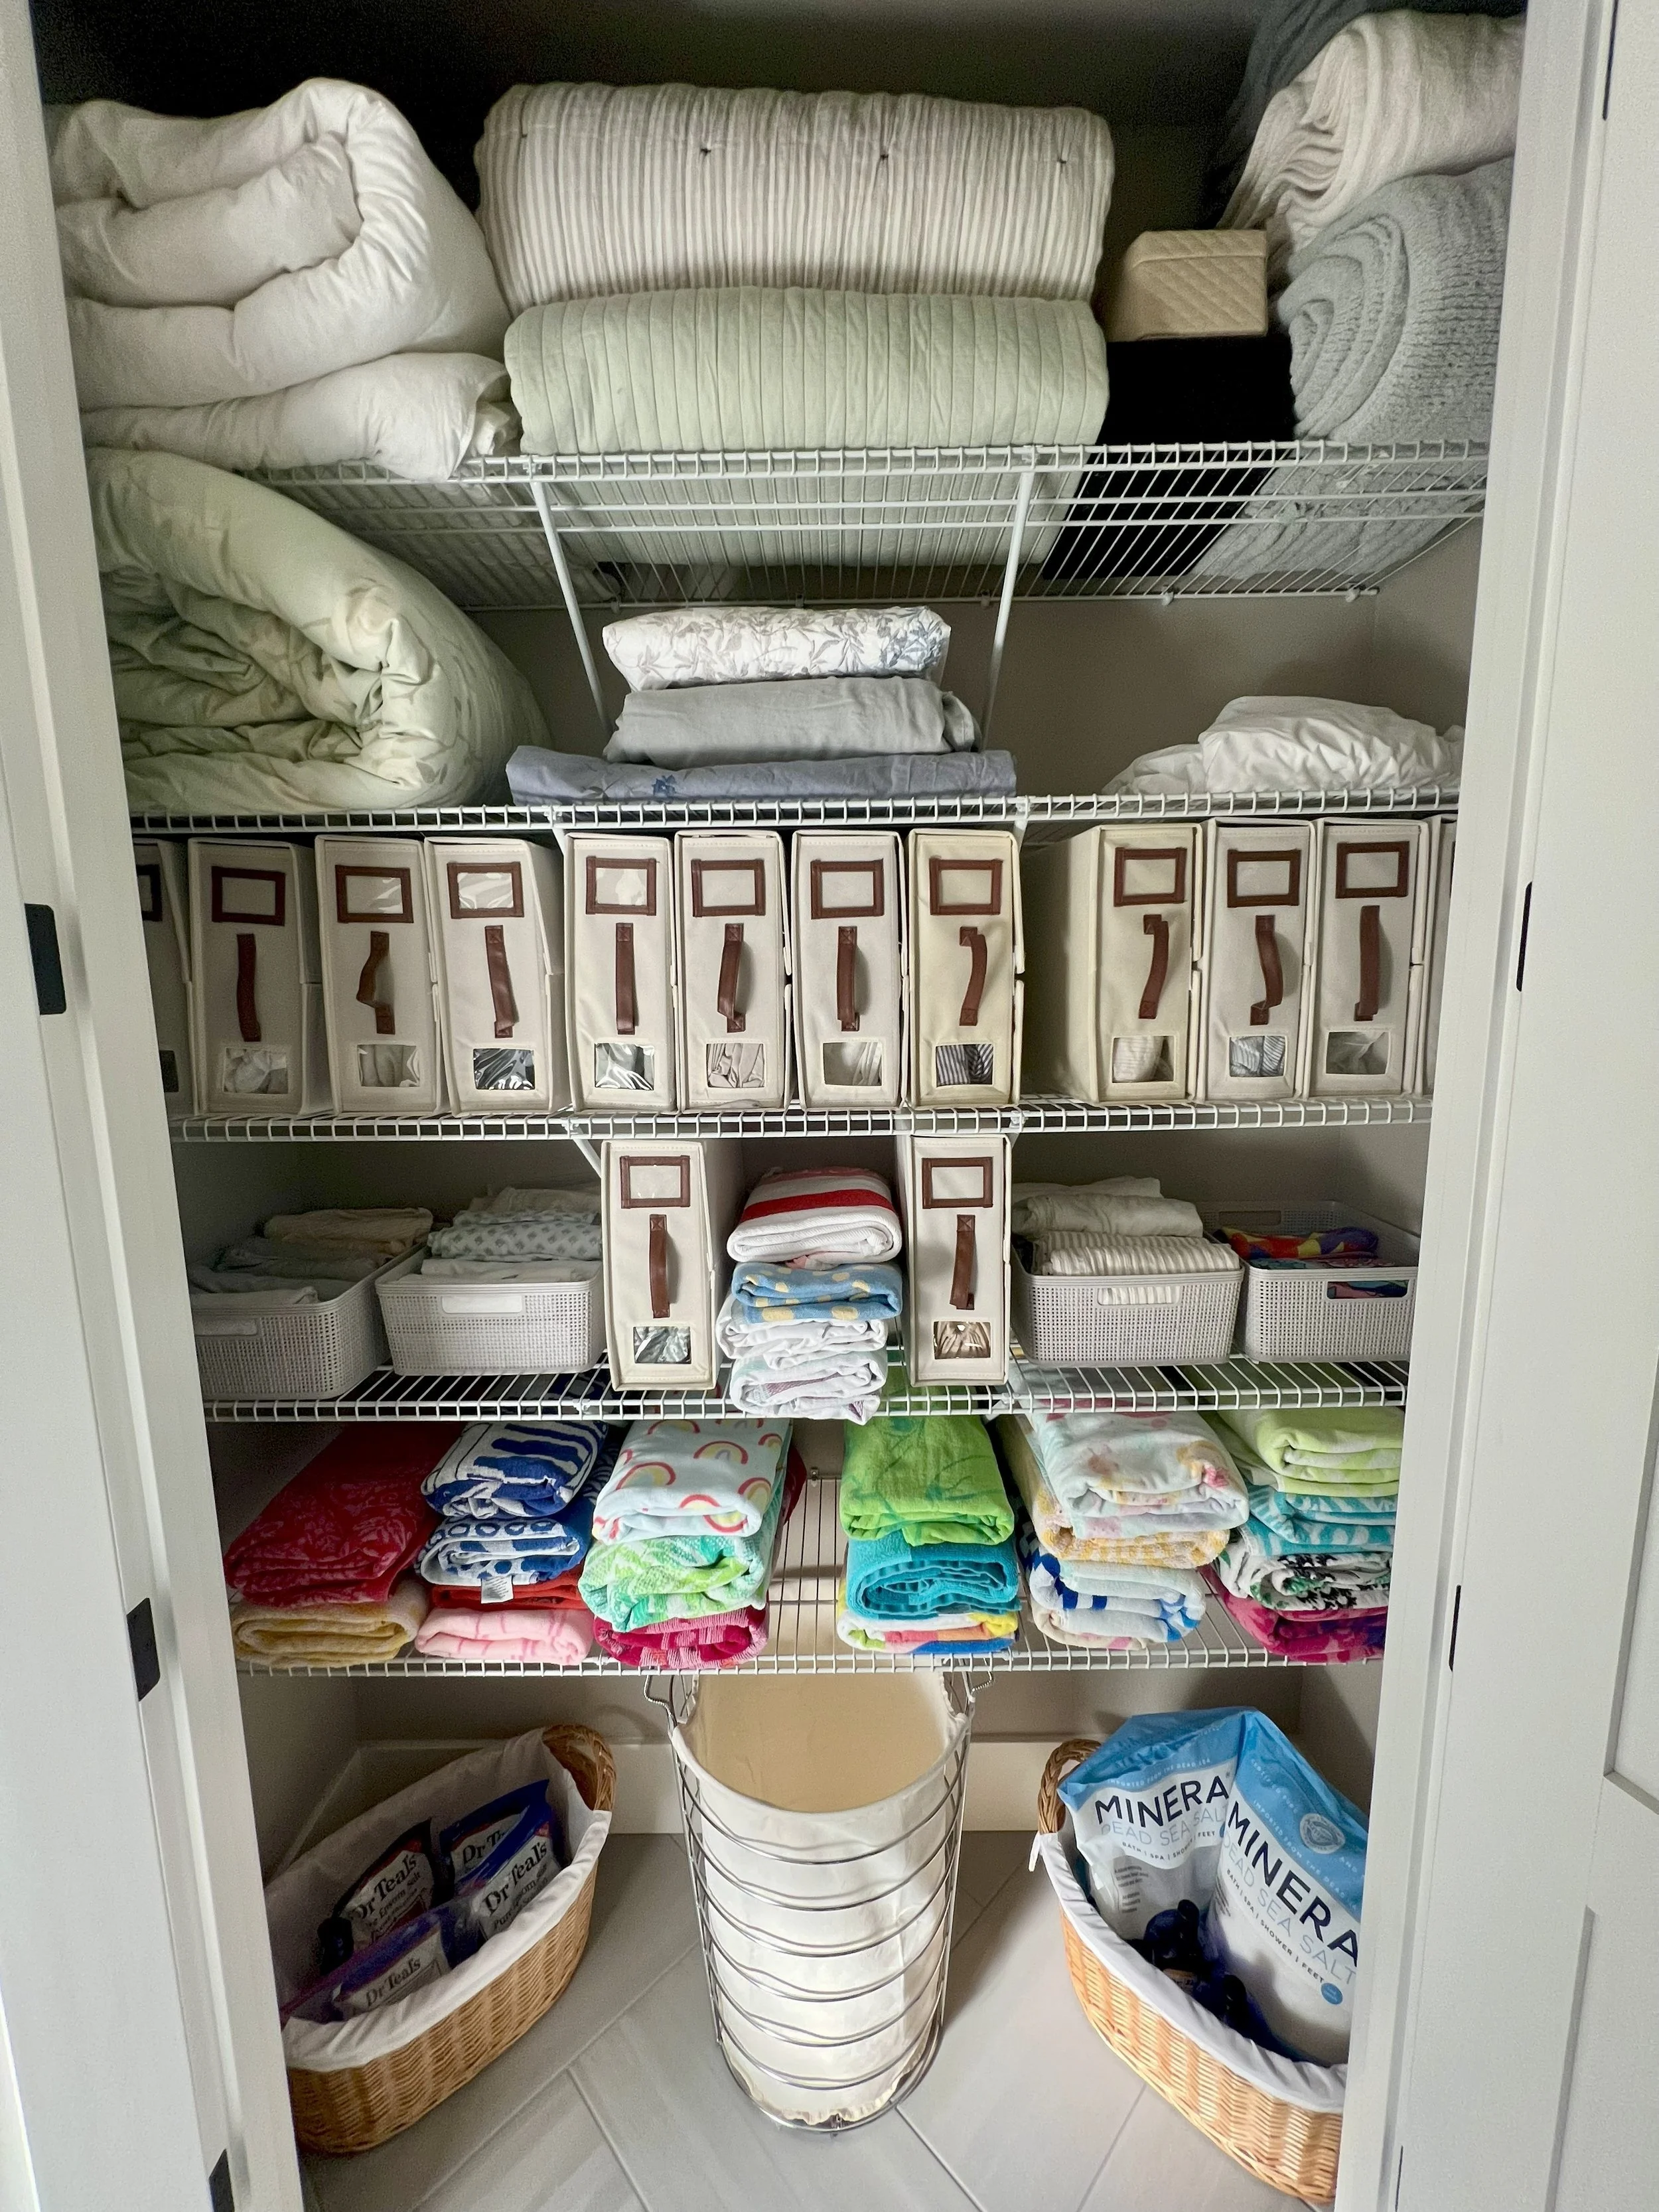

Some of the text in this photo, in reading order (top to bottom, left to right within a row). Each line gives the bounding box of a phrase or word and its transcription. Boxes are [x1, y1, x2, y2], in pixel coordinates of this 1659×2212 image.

[1095, 1775, 1229, 1828] MINERA
[1101, 1820, 1152, 1845] DEAD
[1161, 1820, 1190, 1846] SEA
[1122, 1841, 1142, 1852] BATH
[463, 1844, 486, 1864] Dr
[482, 1883, 509, 1917] Dr
[1228, 1801, 1358, 1968] MINERA
[1223, 1830, 1256, 1887] DEAD
[1258, 1887, 1291, 1938] SEA
[1299, 1934, 1356, 1984] SALT
[1227, 1869, 1325, 1984] BATH SPA SHOWER FEET
[366, 1985, 385, 2007] Dr
